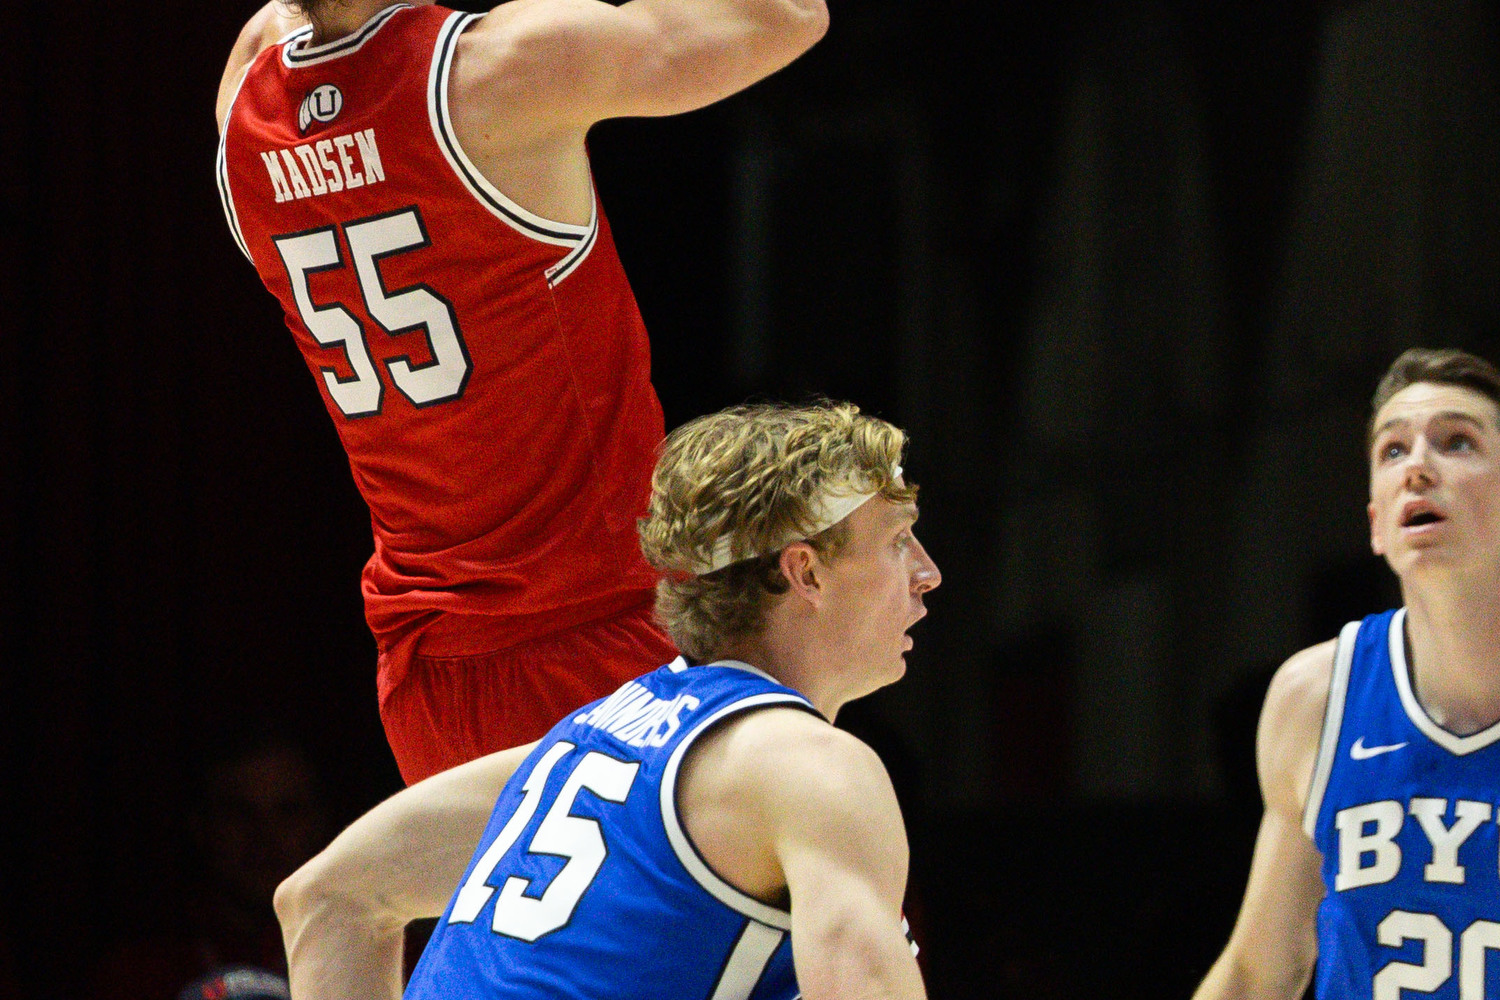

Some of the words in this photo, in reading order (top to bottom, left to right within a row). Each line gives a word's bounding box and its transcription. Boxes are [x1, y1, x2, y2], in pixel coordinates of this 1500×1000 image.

[260, 128, 386, 203] MADSEN
[271, 204, 474, 420] 55
[447, 740, 642, 943] 15
